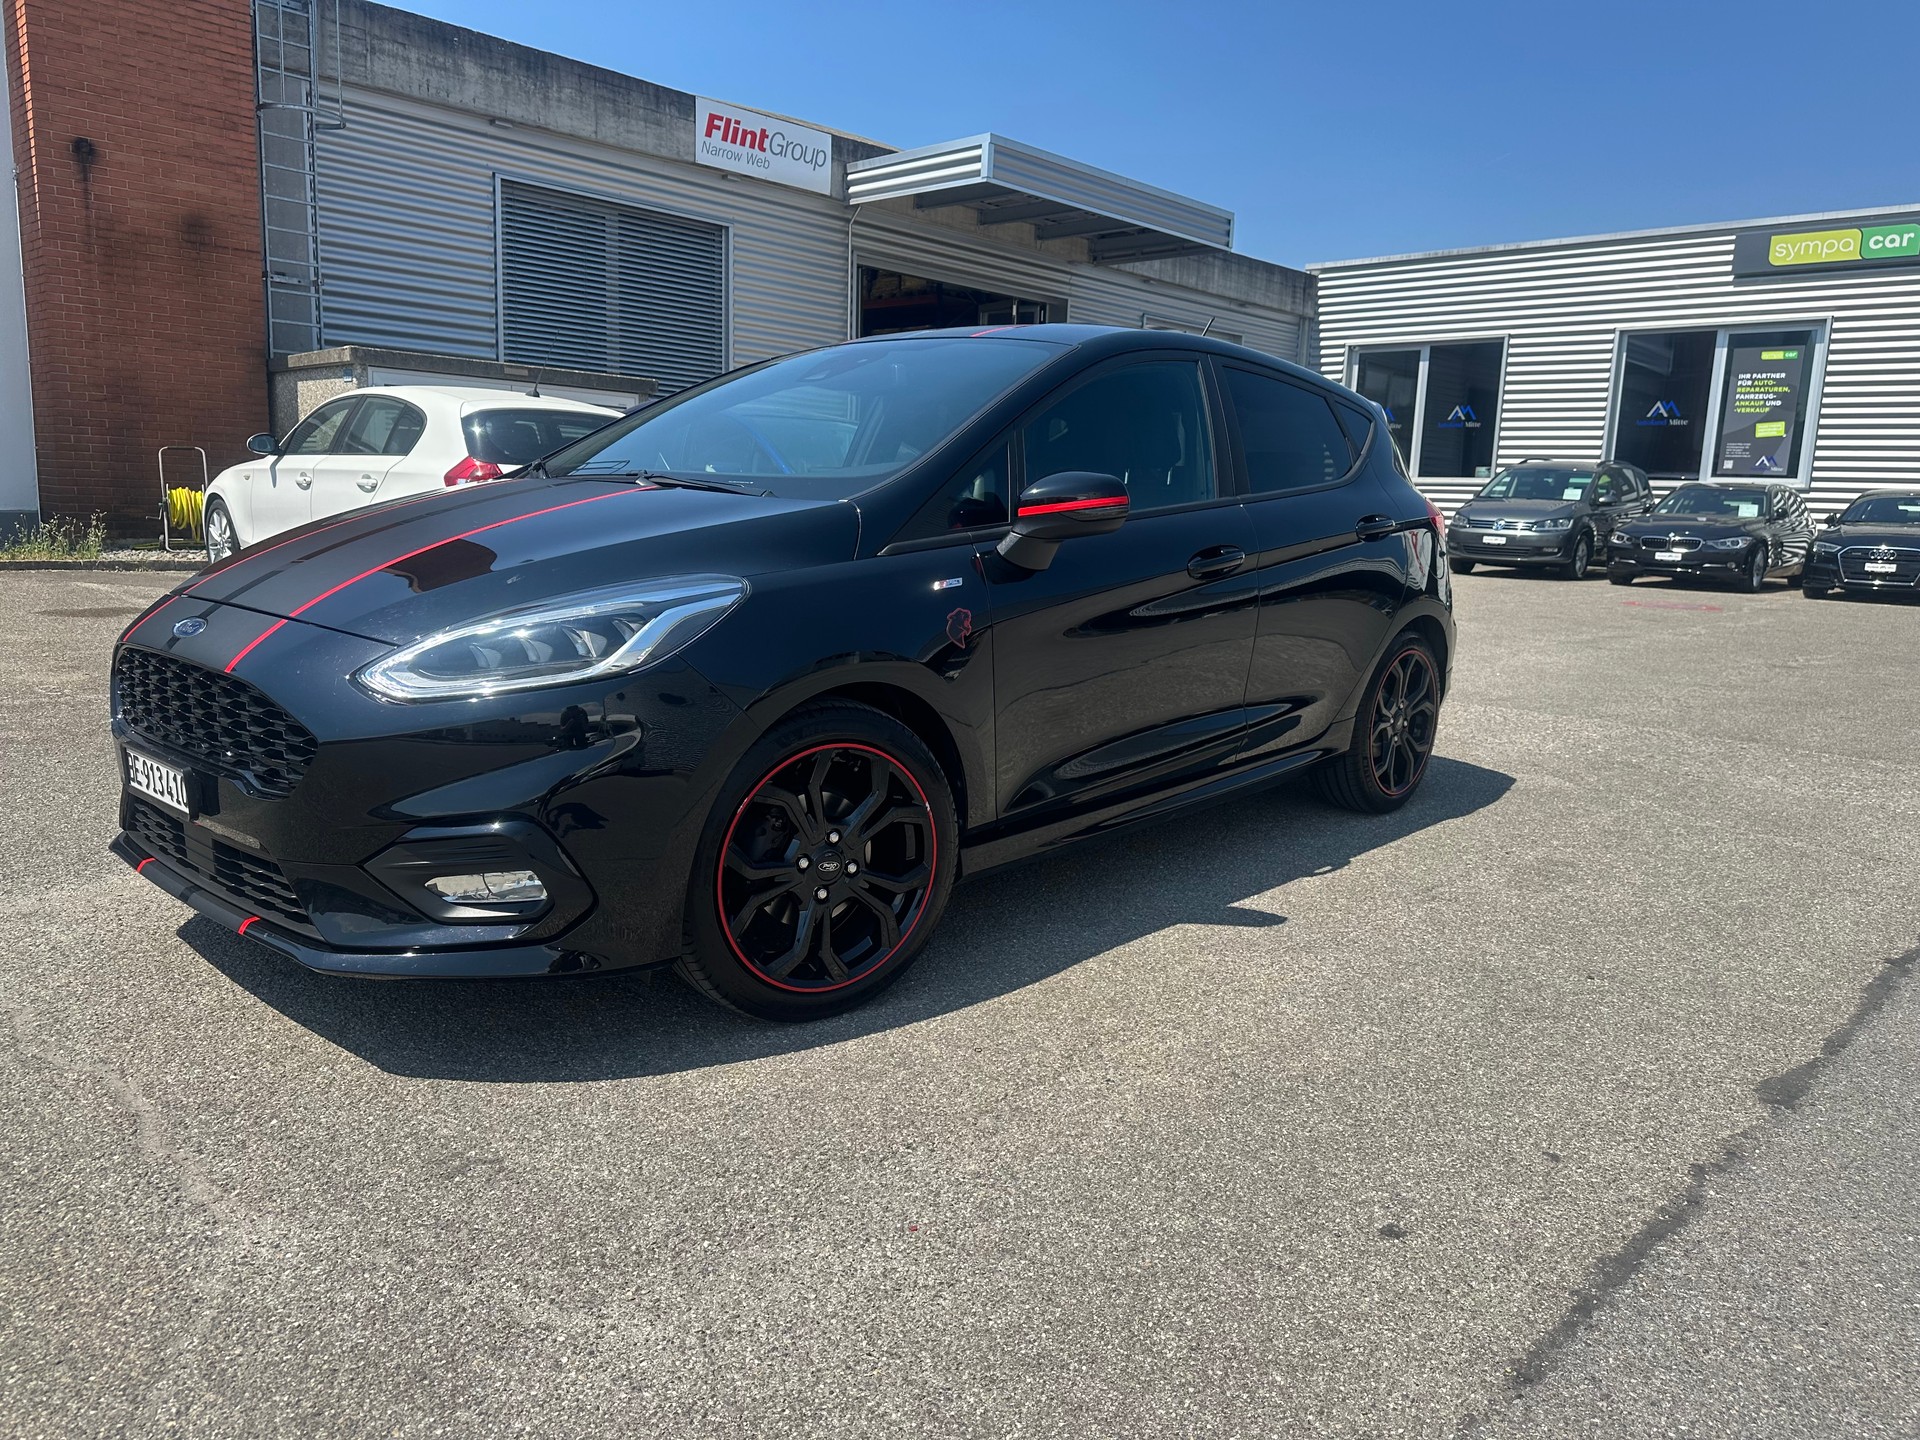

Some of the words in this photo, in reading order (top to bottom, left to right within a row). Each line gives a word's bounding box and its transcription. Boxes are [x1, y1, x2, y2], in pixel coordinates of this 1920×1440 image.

[701, 141, 743, 162] Narrow
[746, 152, 770, 170] Web
[1775, 238, 1854, 261] sympa
[1868, 232, 1915, 250] car
